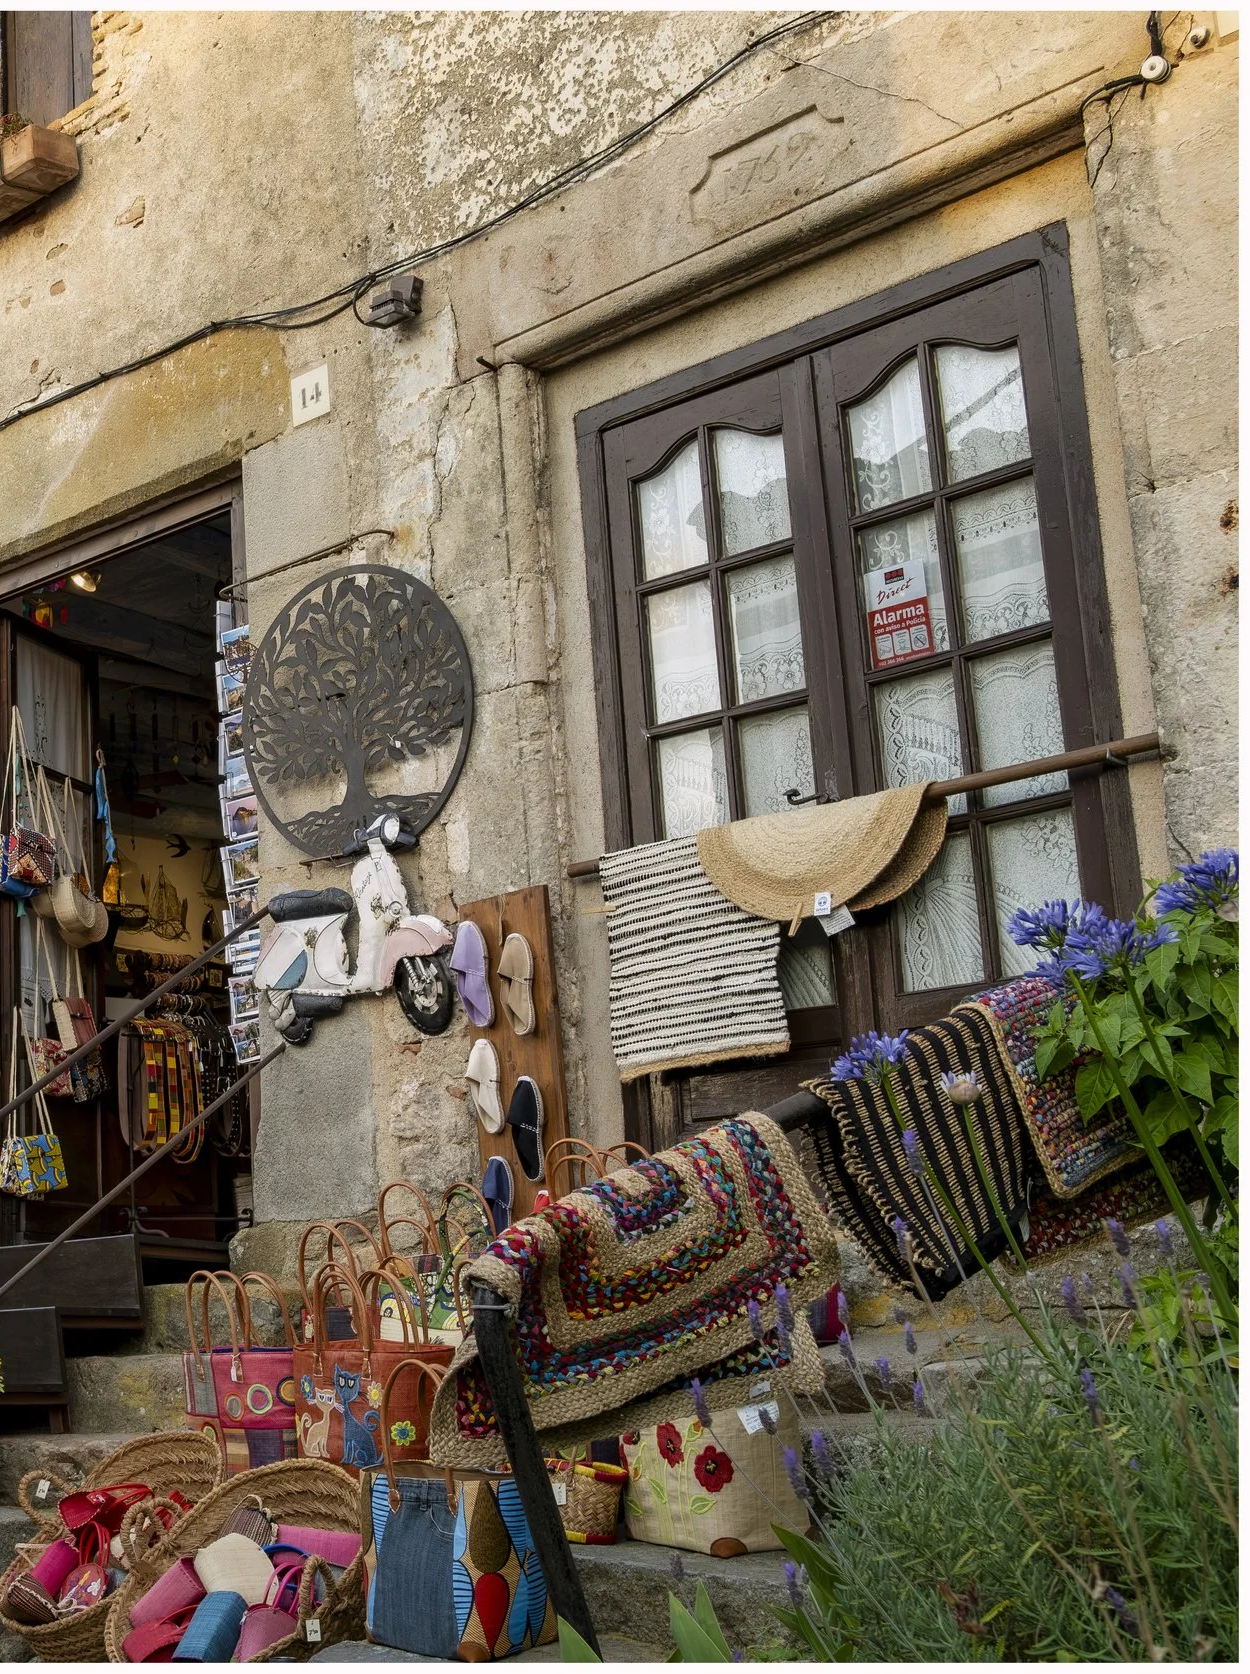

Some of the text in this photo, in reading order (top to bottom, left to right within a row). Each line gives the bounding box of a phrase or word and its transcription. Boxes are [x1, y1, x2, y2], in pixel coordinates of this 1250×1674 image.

[299, 382, 322, 410] 14
[875, 576, 917, 605] Direct
[873, 603, 925, 627] Alarma
[885, 623, 901, 632] aviso
